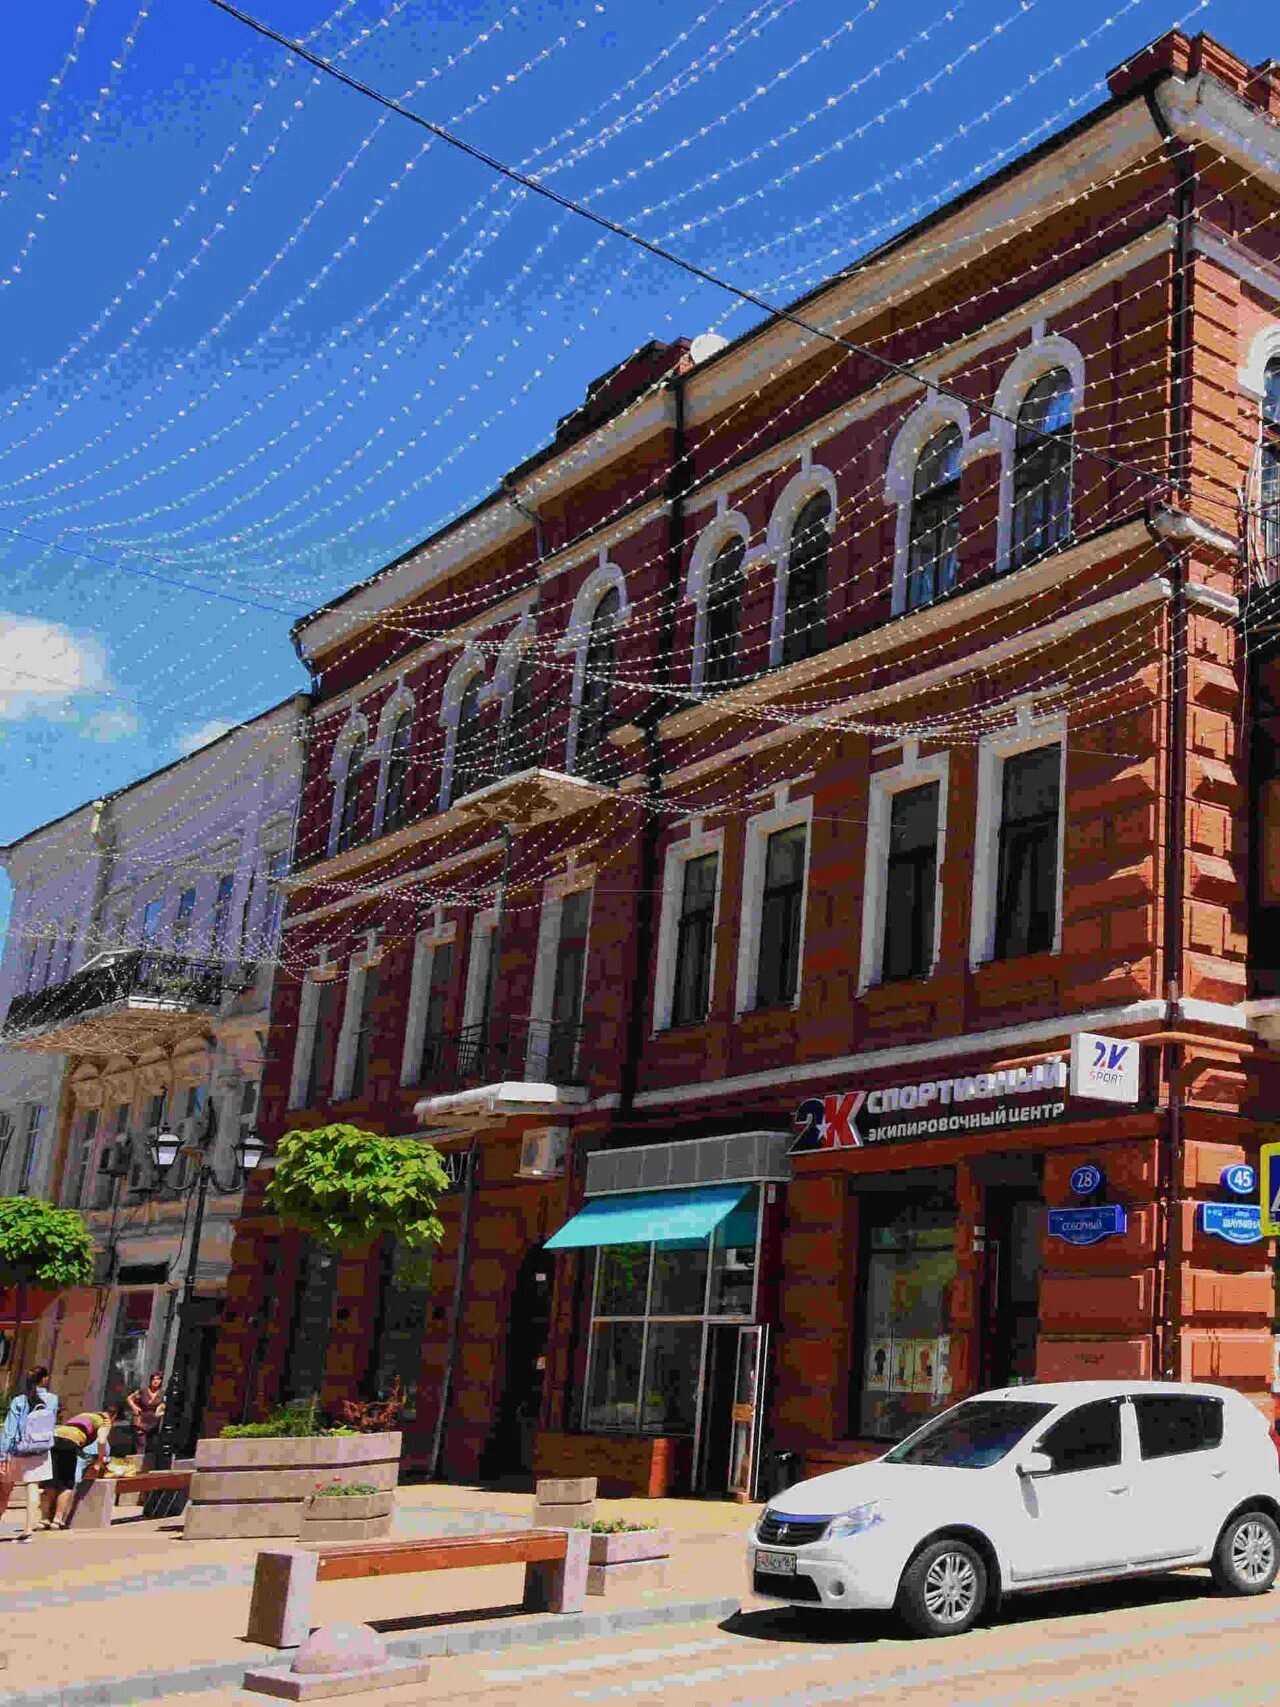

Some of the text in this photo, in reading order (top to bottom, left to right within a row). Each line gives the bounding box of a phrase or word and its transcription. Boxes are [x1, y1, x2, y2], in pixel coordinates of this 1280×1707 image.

[867, 1056, 1067, 1115] СПОРТИВНЫЙ
[1089, 1069, 1125, 1086] SPORT
[867, 1102, 1065, 1142] ЭКИПИРОВОЧНЫЙ ЦЕНТР
[1077, 1172, 1093, 1188] 28
[1234, 1171, 1253, 1187] 45
